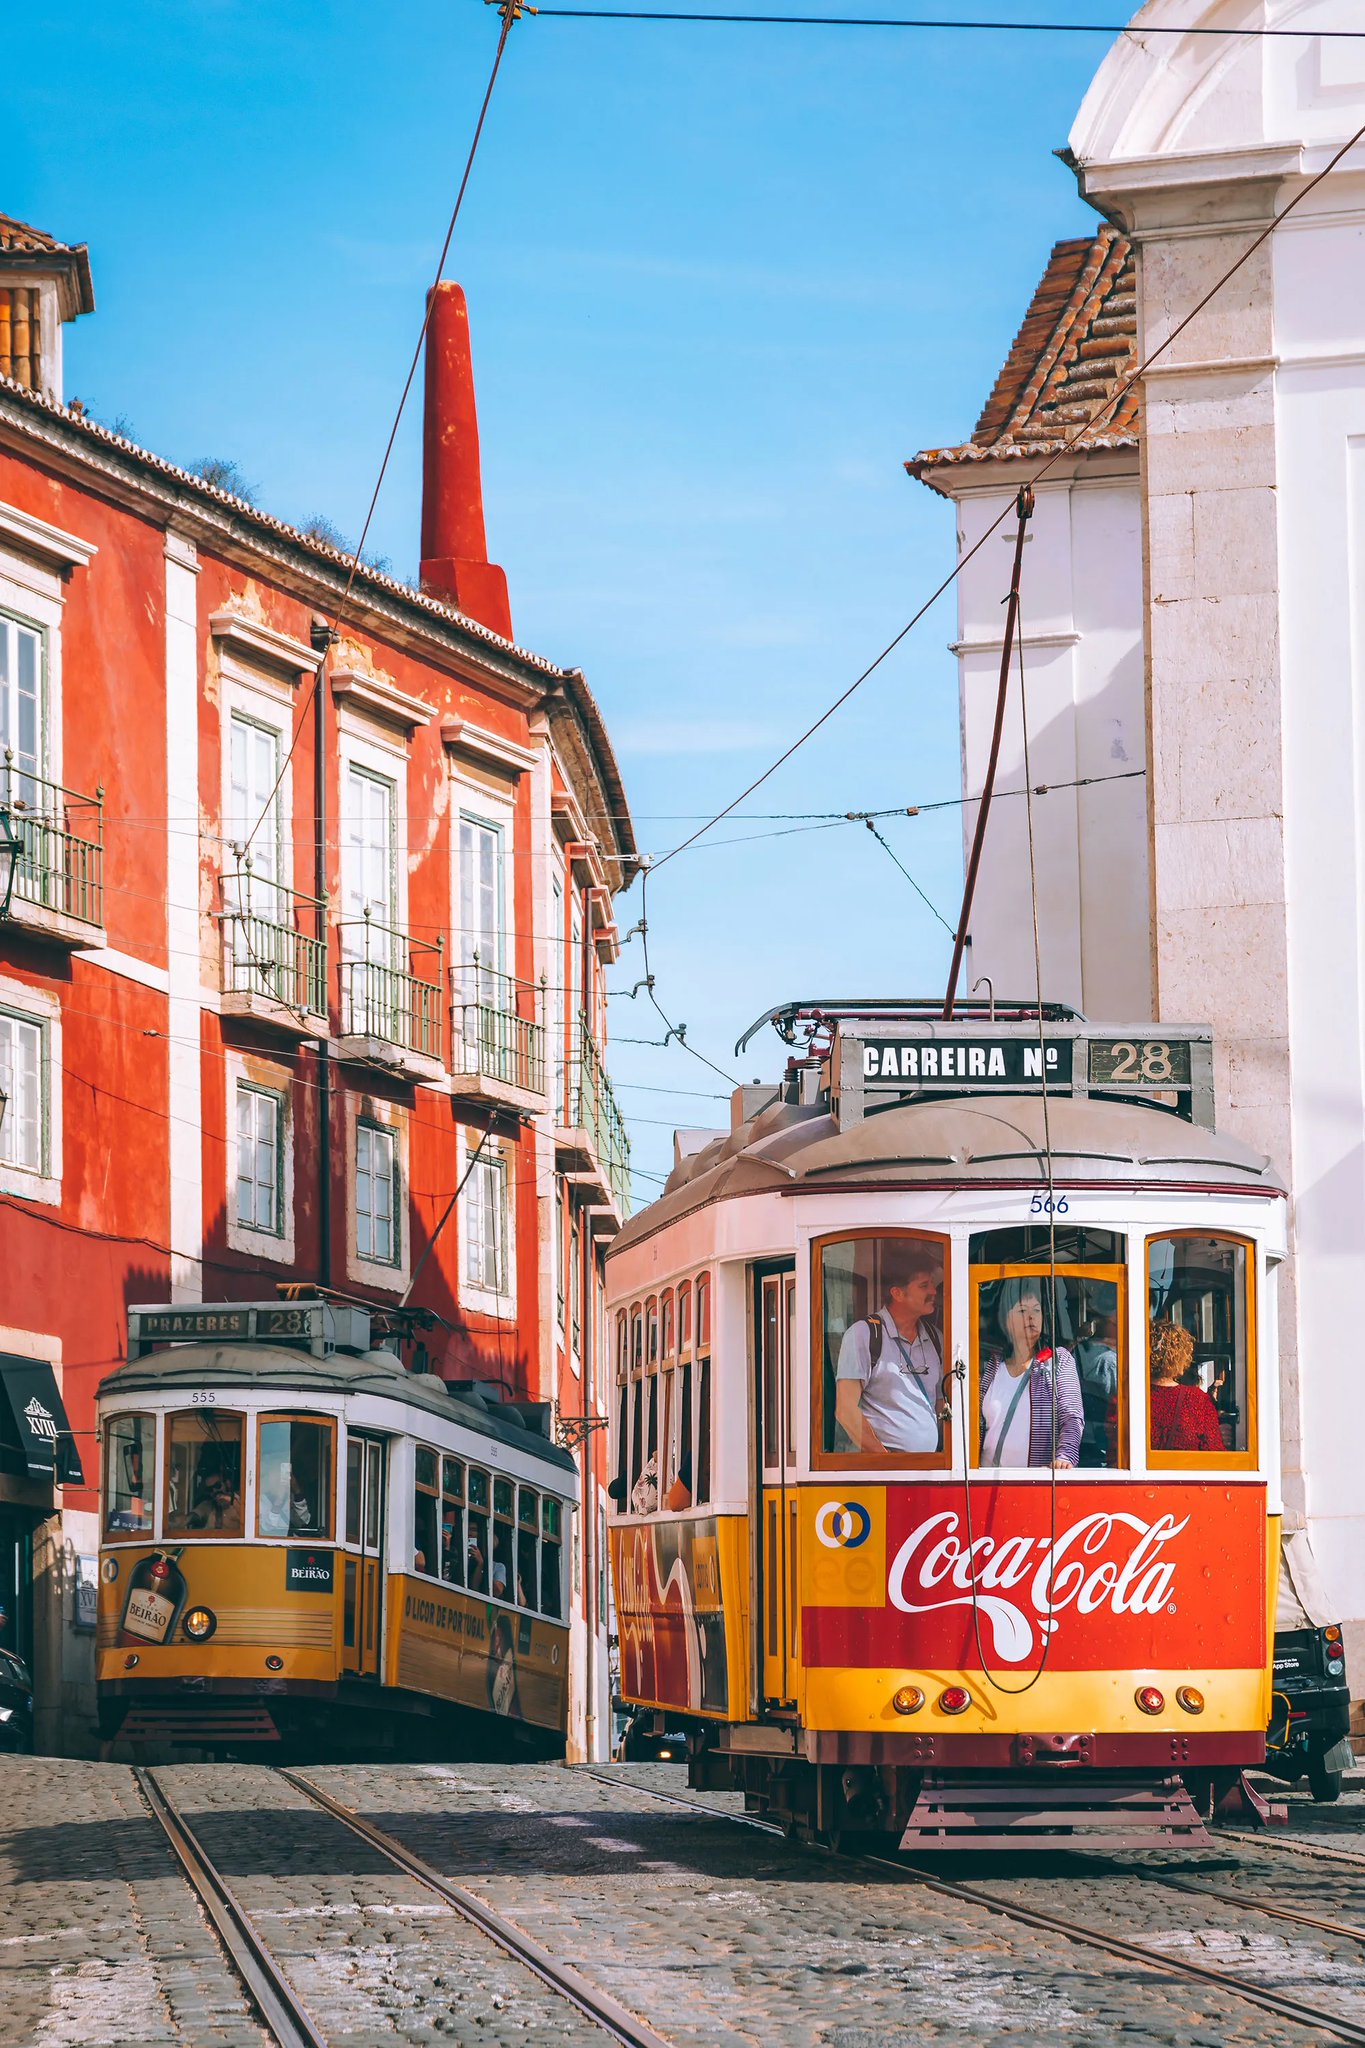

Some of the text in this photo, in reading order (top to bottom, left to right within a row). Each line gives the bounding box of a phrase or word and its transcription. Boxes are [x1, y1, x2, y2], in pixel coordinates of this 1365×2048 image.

[863, 1047, 1006, 1077] CARREIRA
[1110, 1041, 1173, 1081] 28
[1030, 1194, 1070, 1214] 566
[147, 1315, 241, 1332] PRAZERES
[270, 1311, 302, 1334] 28
[192, 1392, 216, 1404] 555
[291, 1567, 330, 1580] BEIRÃO
[887, 1510, 1190, 1662] Coca-Cola
[129, 1602, 167, 1627] BEIRÃO
[412, 1596, 435, 1625] LICOR
[436, 1604, 447, 1629] DE
[448, 1608, 485, 1641] PORTUGAL
[1284, 1661, 1300, 1669] Store
